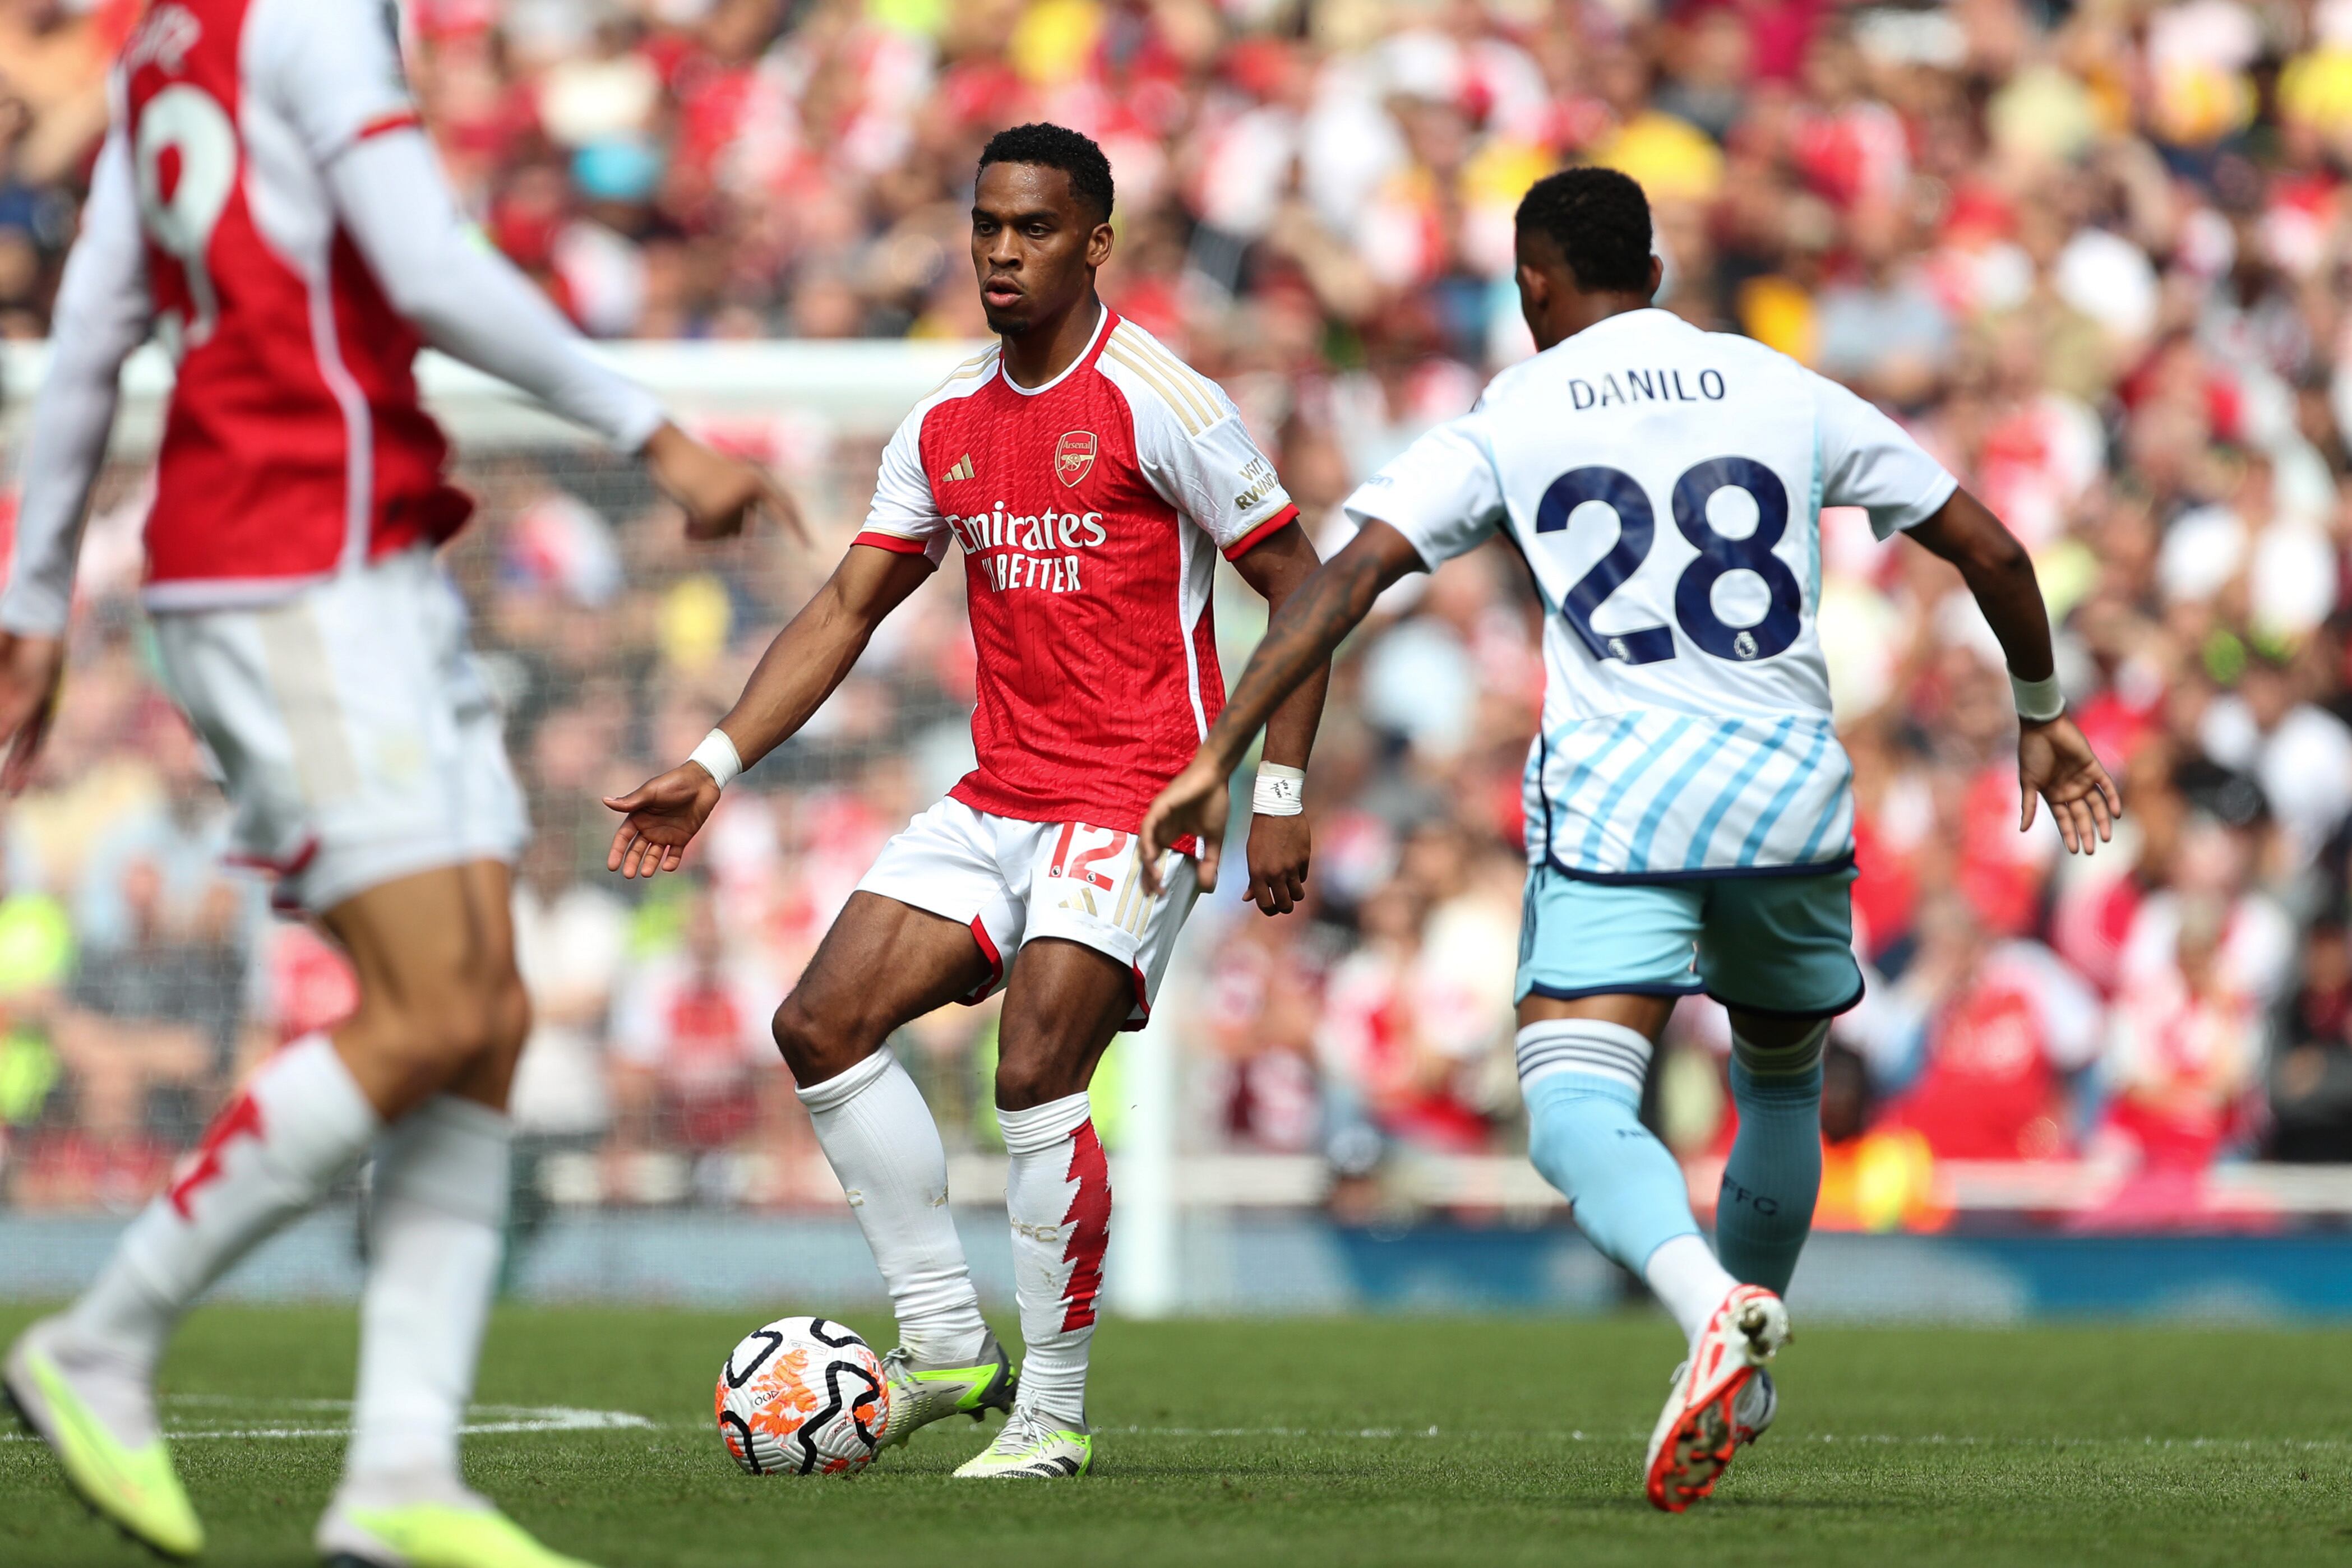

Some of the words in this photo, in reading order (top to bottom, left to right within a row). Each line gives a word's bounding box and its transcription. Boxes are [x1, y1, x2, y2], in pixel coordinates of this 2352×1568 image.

[1569, 368, 1725, 410] DANILO
[1237, 457, 1264, 481] VISIT
[945, 500, 1107, 555] Emirates
[997, 553, 1081, 593] BETTER
[1535, 455, 1801, 665] 28
[1048, 821, 1128, 891] 12
